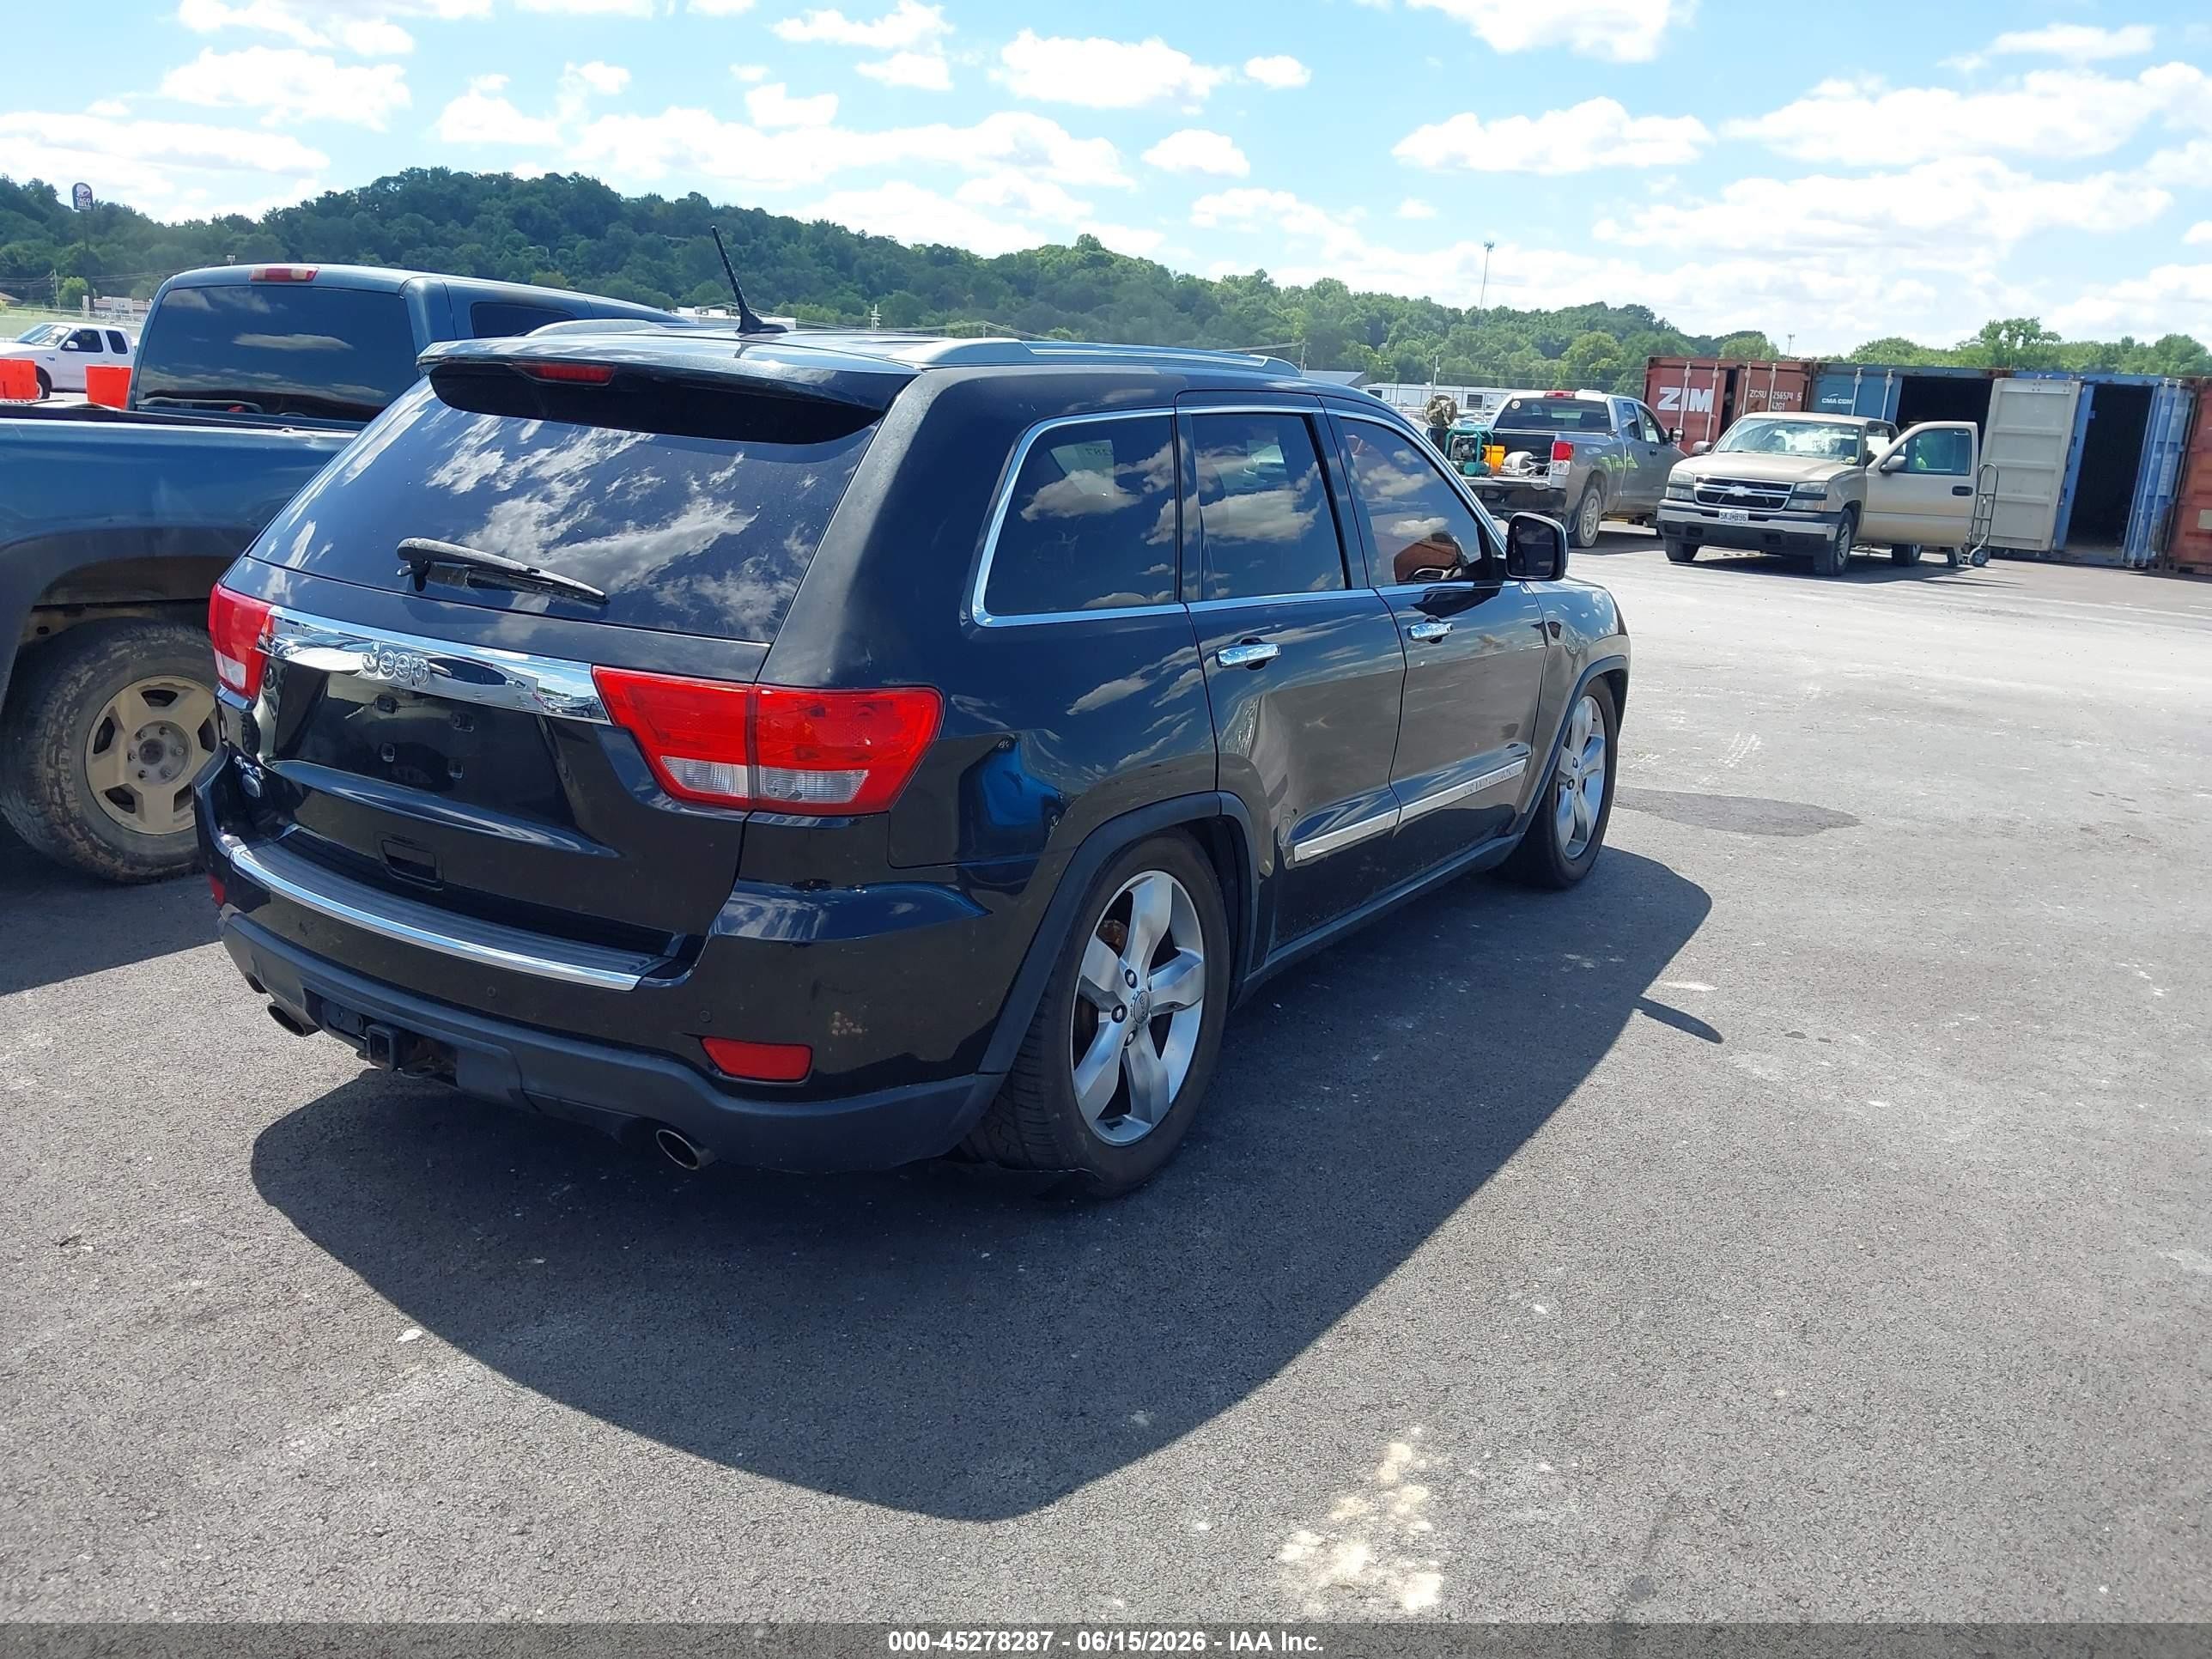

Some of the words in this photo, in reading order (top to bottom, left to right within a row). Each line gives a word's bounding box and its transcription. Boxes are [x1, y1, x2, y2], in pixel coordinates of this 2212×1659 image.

[1657, 386, 1713, 413] ZIM
[1748, 389, 1767, 399] ZCSU
[362, 639, 430, 688] Jeep
